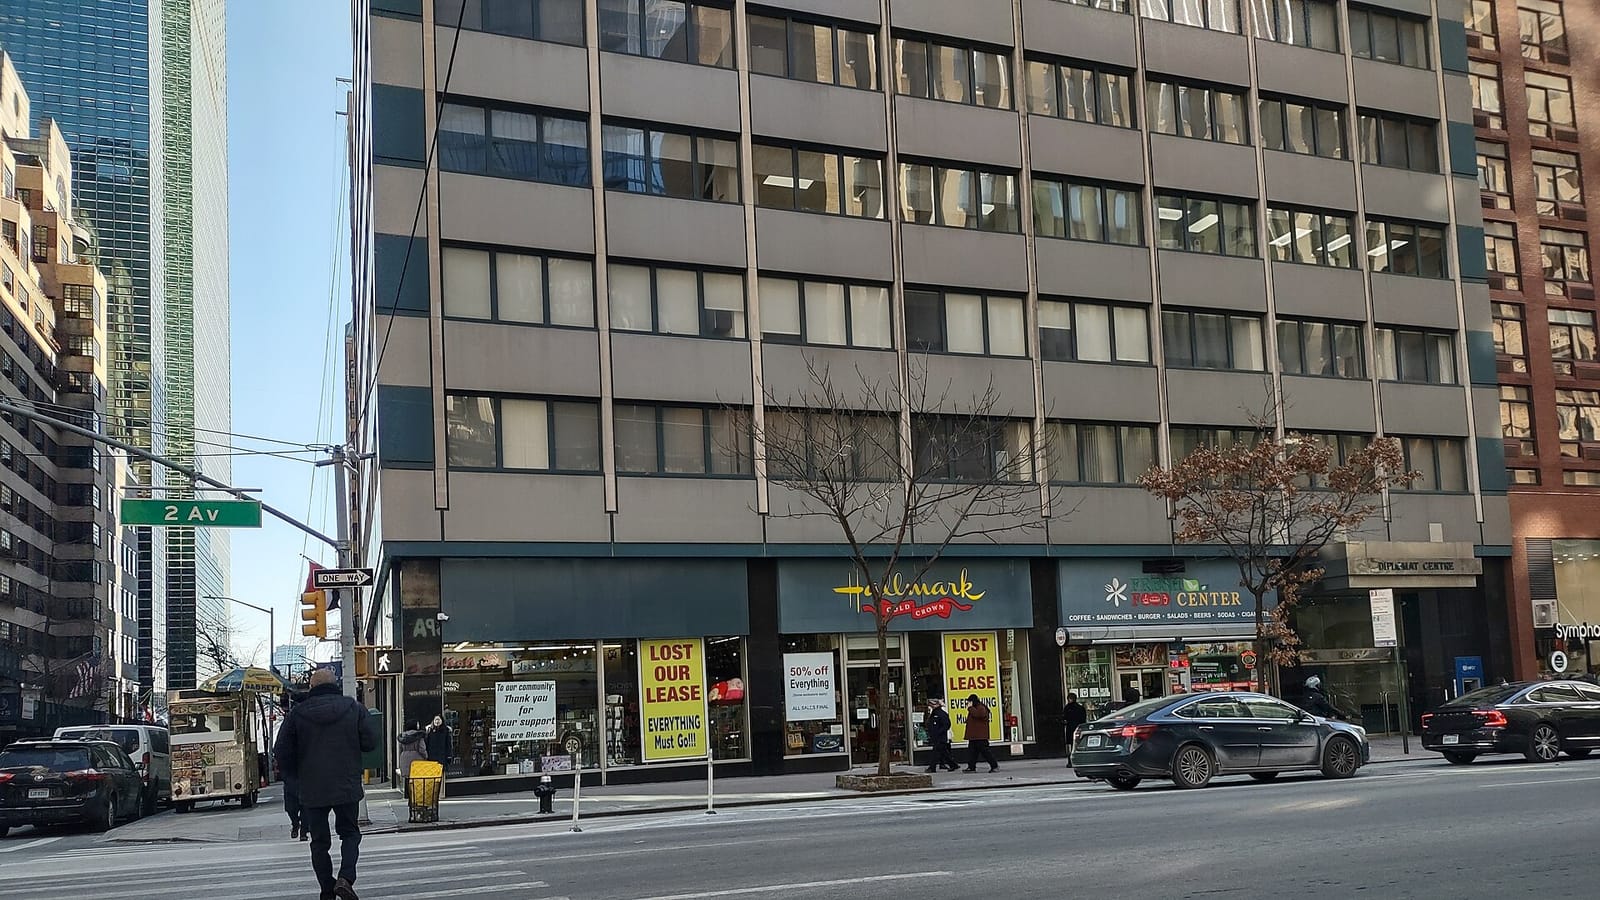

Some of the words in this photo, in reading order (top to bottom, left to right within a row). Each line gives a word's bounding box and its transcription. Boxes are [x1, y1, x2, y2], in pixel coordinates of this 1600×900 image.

[165, 505, 178, 521] 2
[187, 505, 219, 521] Av
[1422, 561, 1455, 571] CENTRE
[322, 574, 340, 582] ONE
[347, 573, 365, 581] WAY
[832, 567, 986, 613] Hallmark
[1131, 592, 1170, 607] FOOD
[1176, 591, 1242, 607] CENTER
[915, 604, 944, 617] CROWN
[1096, 613, 1133, 621] SANDWICHES
[1556, 622, 1600, 641] Sympho
[952, 638, 988, 652] LOST
[650, 644, 693, 661] LOST
[956, 657, 986, 671] OUR
[655, 665, 690, 681] OUR
[790, 666, 811, 677] 50%
[814, 666, 829, 676] off
[497, 683, 504, 691] To
[790, 678, 829, 690] Everything
[949, 676, 995, 690] LEASE
[504, 693, 531, 703] Thank
[533, 695, 548, 704] you
[646, 685, 701, 703] LEASE
[519, 705, 534, 716] for
[496, 719, 517, 729] your
[519, 717, 555, 728] support
[648, 715, 701, 732] EVERYTHING
[497, 732, 508, 740] We
[654, 735, 675, 750] Must
[677, 733, 697, 749] Go!!!
